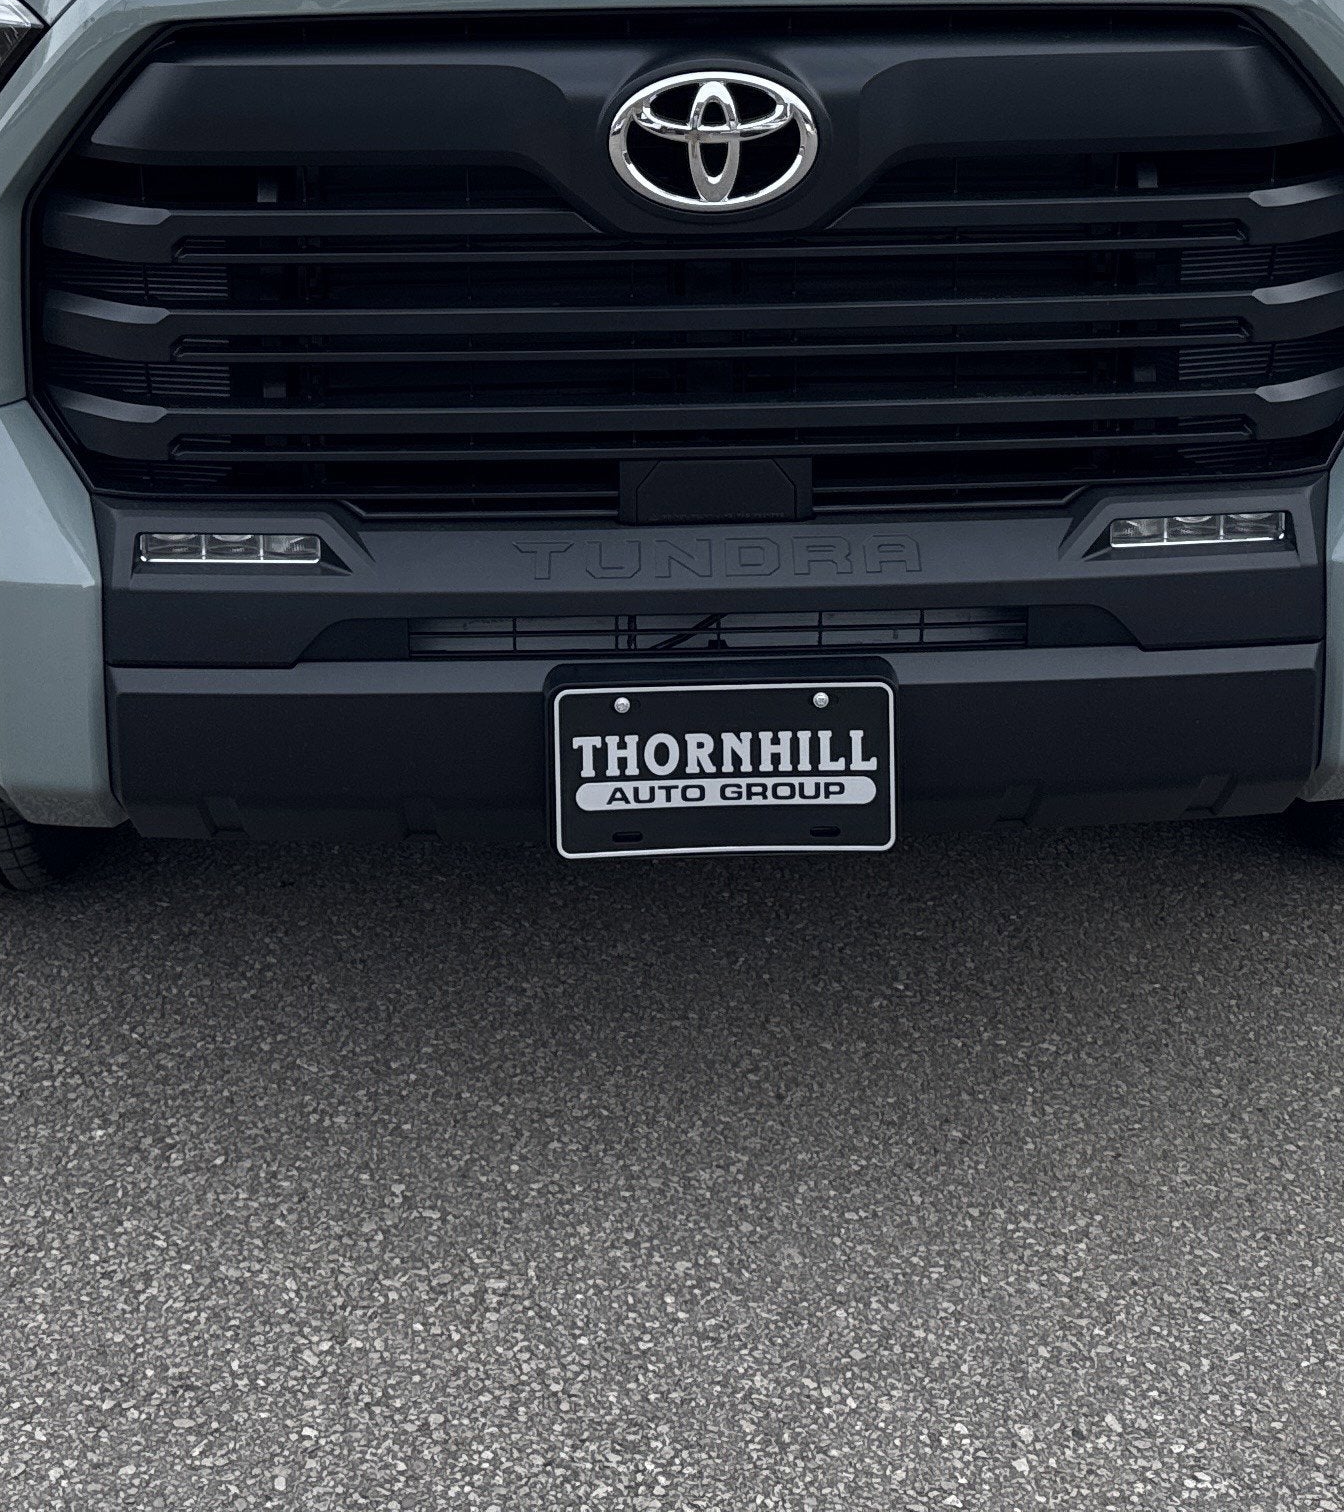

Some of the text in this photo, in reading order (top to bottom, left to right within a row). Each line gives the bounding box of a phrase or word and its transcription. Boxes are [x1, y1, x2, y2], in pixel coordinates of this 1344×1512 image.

[512, 534, 922, 580] TUNDRA
[572, 729, 878, 778] THORNHILL
[606, 781, 846, 805] AUTO GROUP
